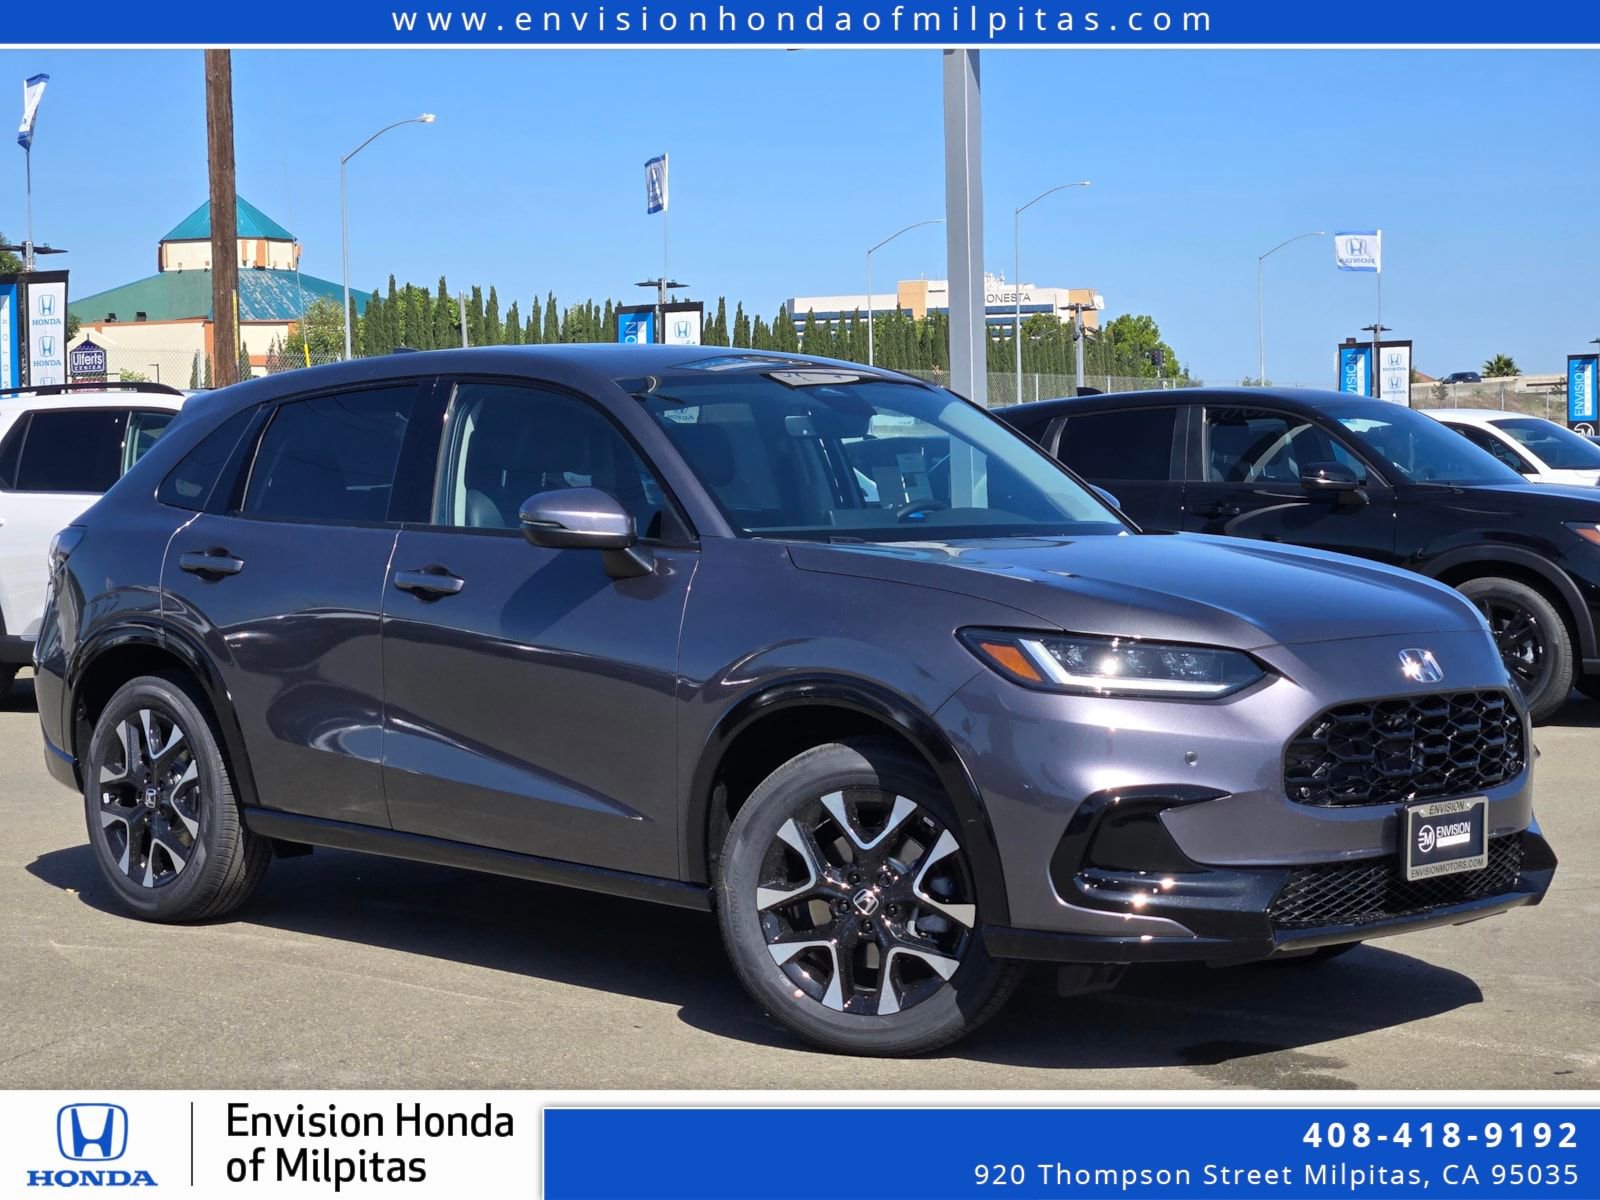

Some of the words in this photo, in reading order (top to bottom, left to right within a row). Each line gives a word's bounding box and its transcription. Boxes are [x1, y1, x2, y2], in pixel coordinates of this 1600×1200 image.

[986, 292, 1031, 303] ONESTA
[72, 353, 102, 365] Ulferts
[1346, 353, 1358, 394] VISION
[1574, 364, 1585, 416] ENVISION
[1429, 801, 1465, 815] ENVISION
[1436, 821, 1471, 838] ENVISION
[1410, 857, 1484, 879] ENVISIONMOTORS.COM
